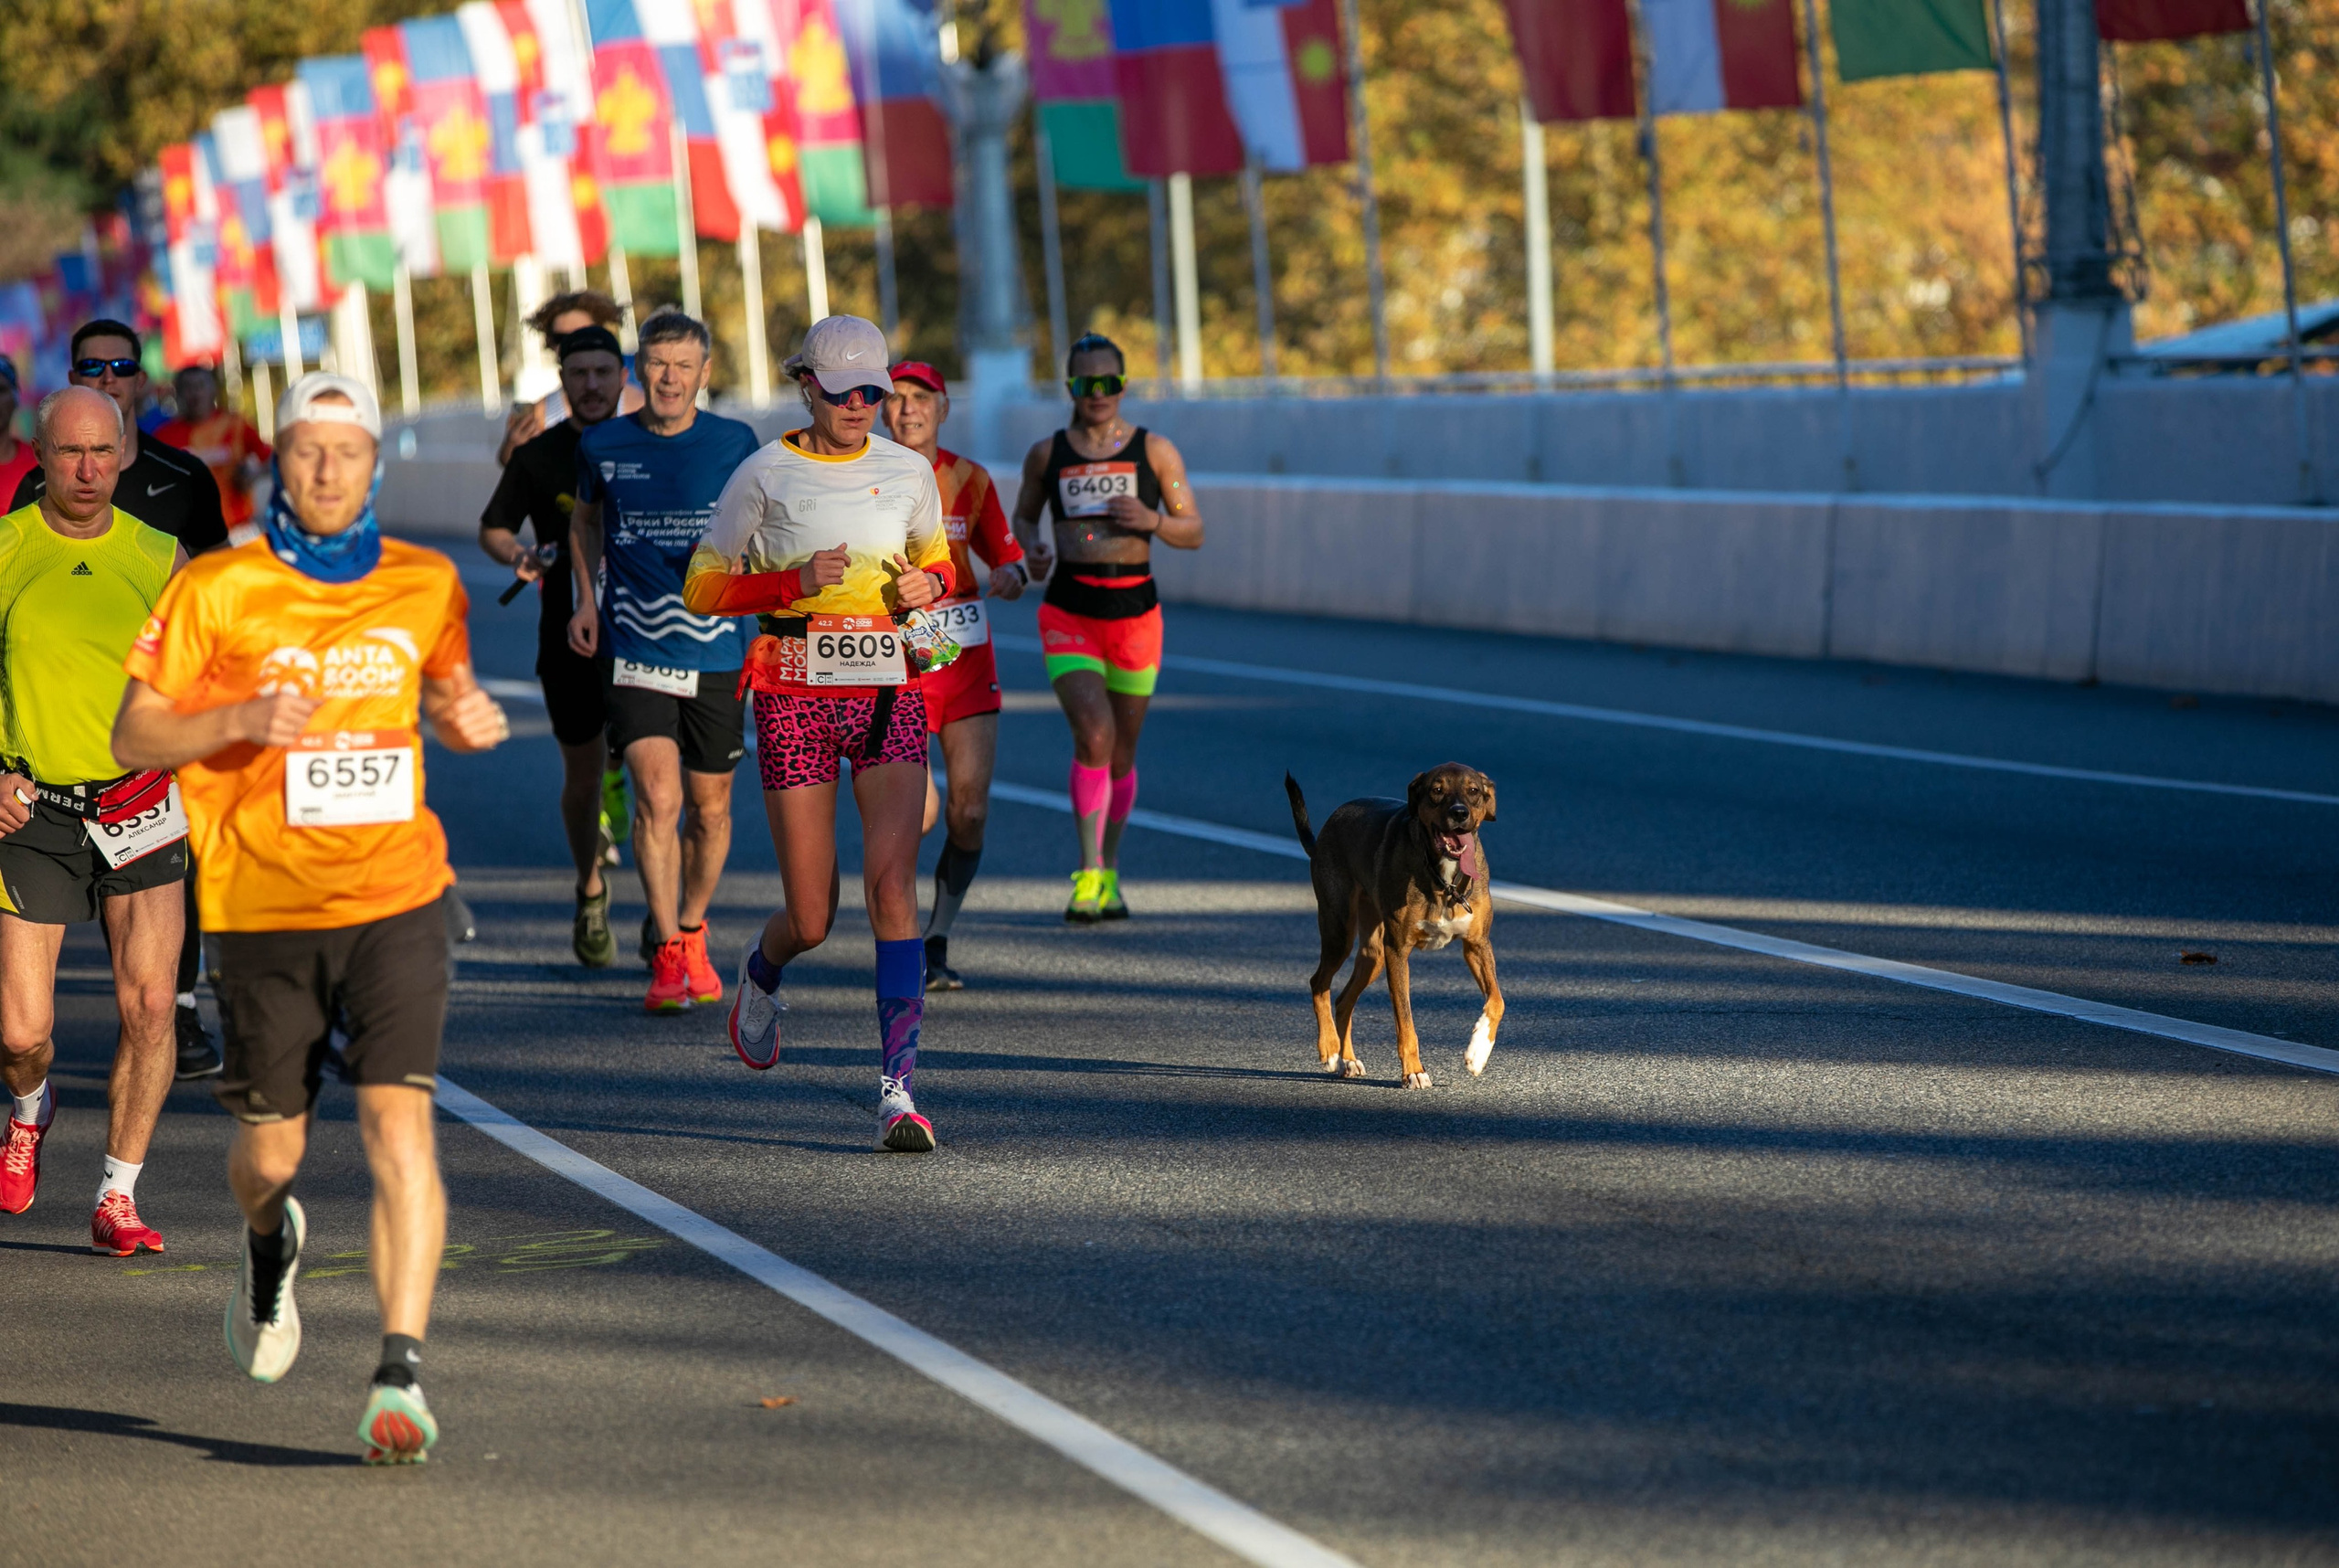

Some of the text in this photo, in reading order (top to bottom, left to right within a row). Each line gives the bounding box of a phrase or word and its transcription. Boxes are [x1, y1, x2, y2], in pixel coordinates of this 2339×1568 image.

[1066, 475, 1127, 497] 6403
[799, 498, 817, 513] GRi
[627, 516, 661, 527] Реки
[323, 644, 395, 664] ANTA
[817, 635, 895, 659] 6609
[307, 754, 400, 789] 6557
[128, 817, 167, 840] АЛЕКСАНДР
